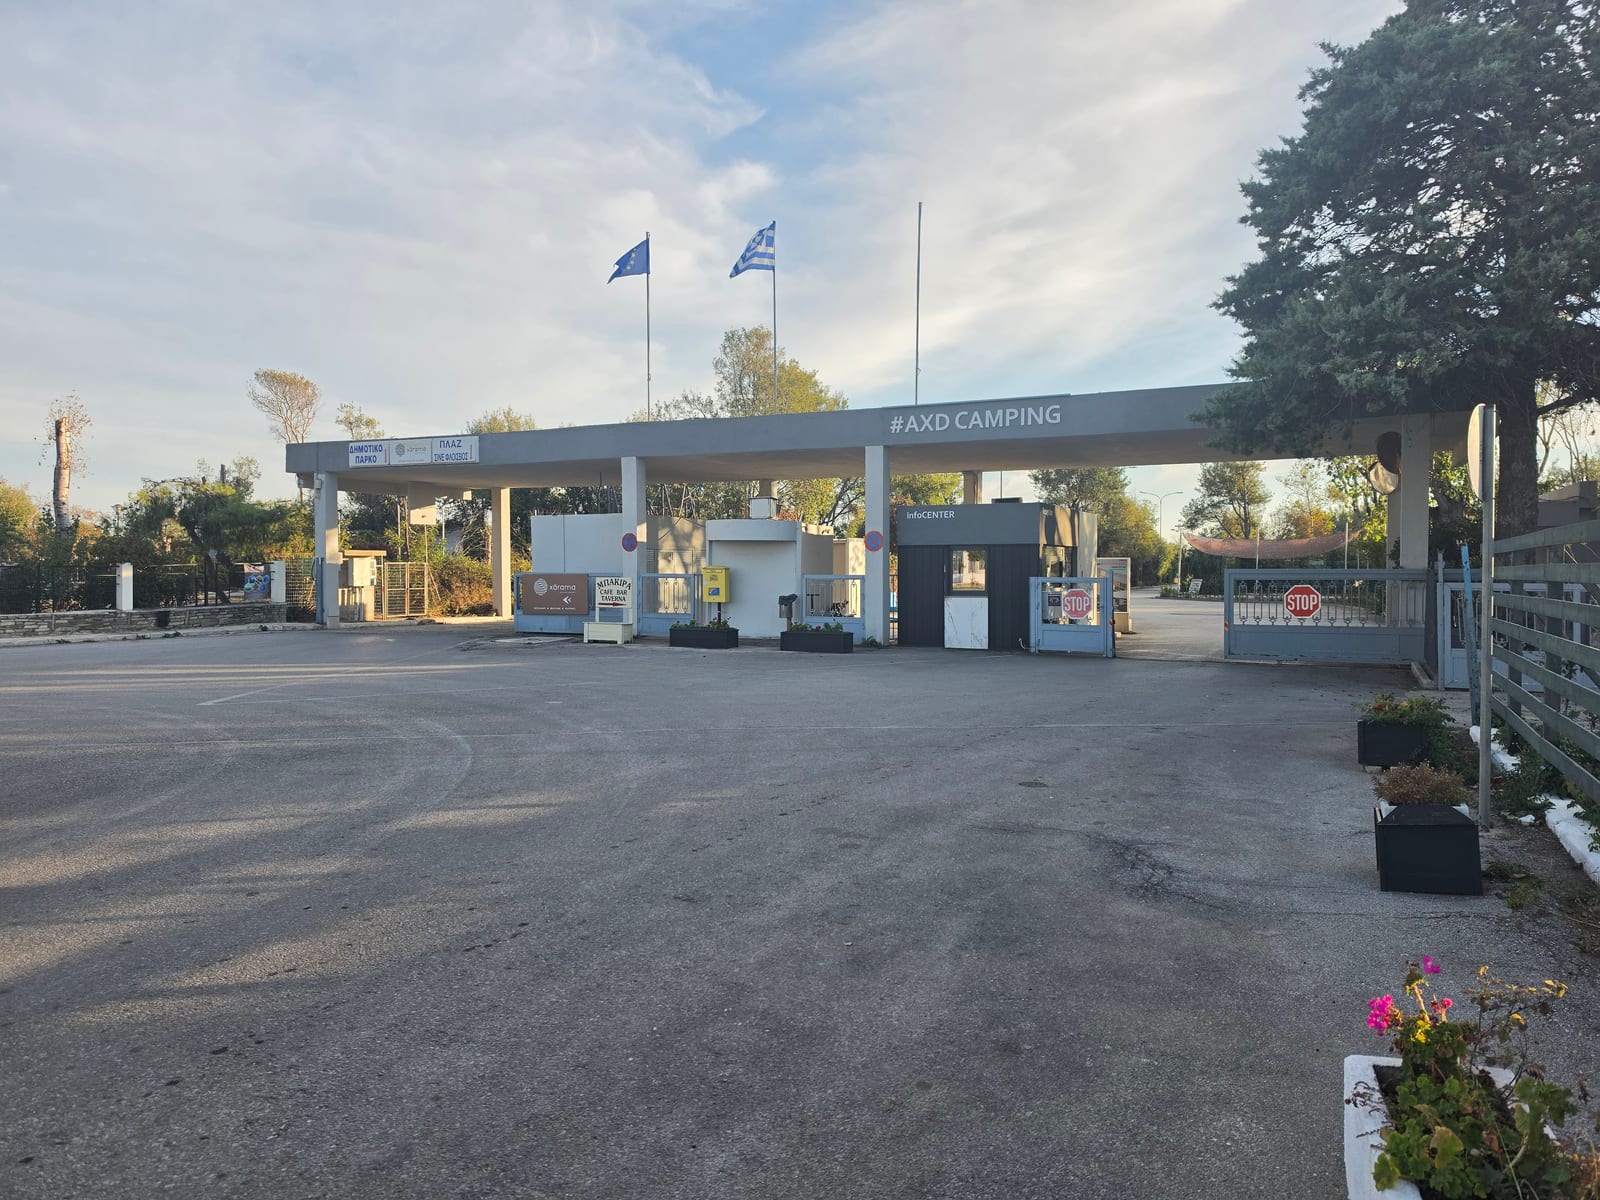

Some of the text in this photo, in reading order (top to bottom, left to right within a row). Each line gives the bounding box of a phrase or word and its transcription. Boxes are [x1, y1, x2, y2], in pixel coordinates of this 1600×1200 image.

[890, 405, 1061, 433] #AXD CAMPING
[349, 444, 383, 454] ΔΗΜΟΤΙΚΟ
[439, 440, 462, 448] ΠΛΑΖ
[355, 455, 377, 464] ΠΑΡΚΟ
[906, 511, 955, 519] infoCENTER
[1064, 596, 1090, 612] STOP
[1287, 594, 1318, 610] STOP
